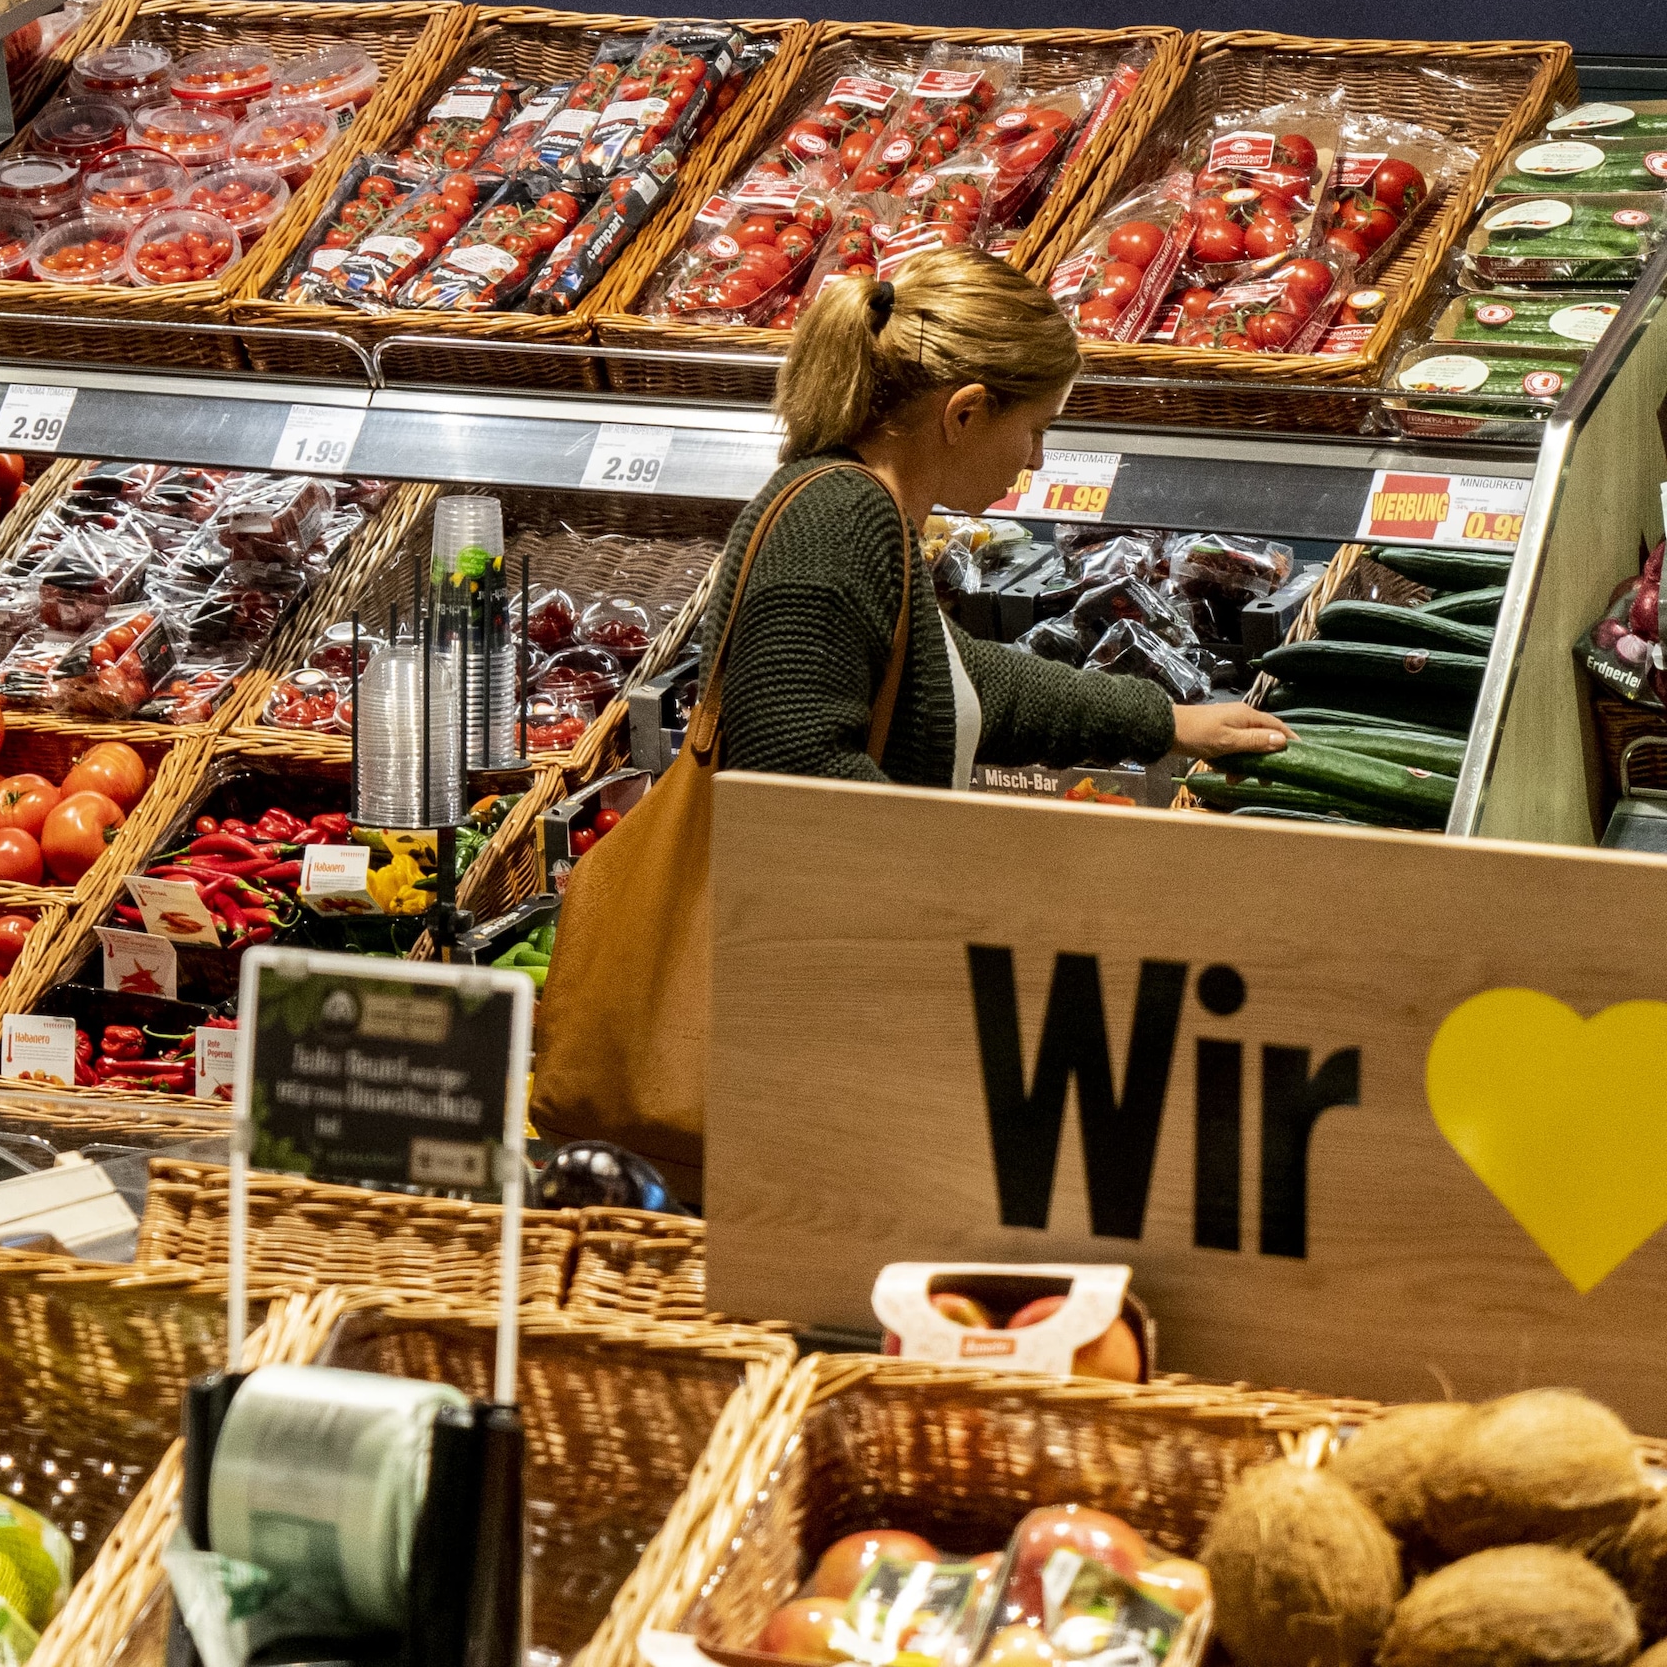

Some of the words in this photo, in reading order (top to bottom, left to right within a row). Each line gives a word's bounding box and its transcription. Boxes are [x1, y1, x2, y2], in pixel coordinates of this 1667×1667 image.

[587, 212, 625, 261] campari
[8, 416, 63, 441] 2.99
[295, 438, 348, 464] 1.99
[602, 456, 660, 482] 2.99
[1460, 478, 1524, 491] MINIGURKEN
[1049, 484, 1109, 513] 1.99
[1371, 492, 1451, 523] WERBUNG
[985, 768, 1059, 793] Misch-Bar
[313, 861, 346, 874] Habanero
[15, 1031, 50, 1044] Habanero
[207, 1038, 221, 1049] Rote
[207, 1047, 233, 1060] Peperoni
[967, 942, 1362, 1260] Wir
